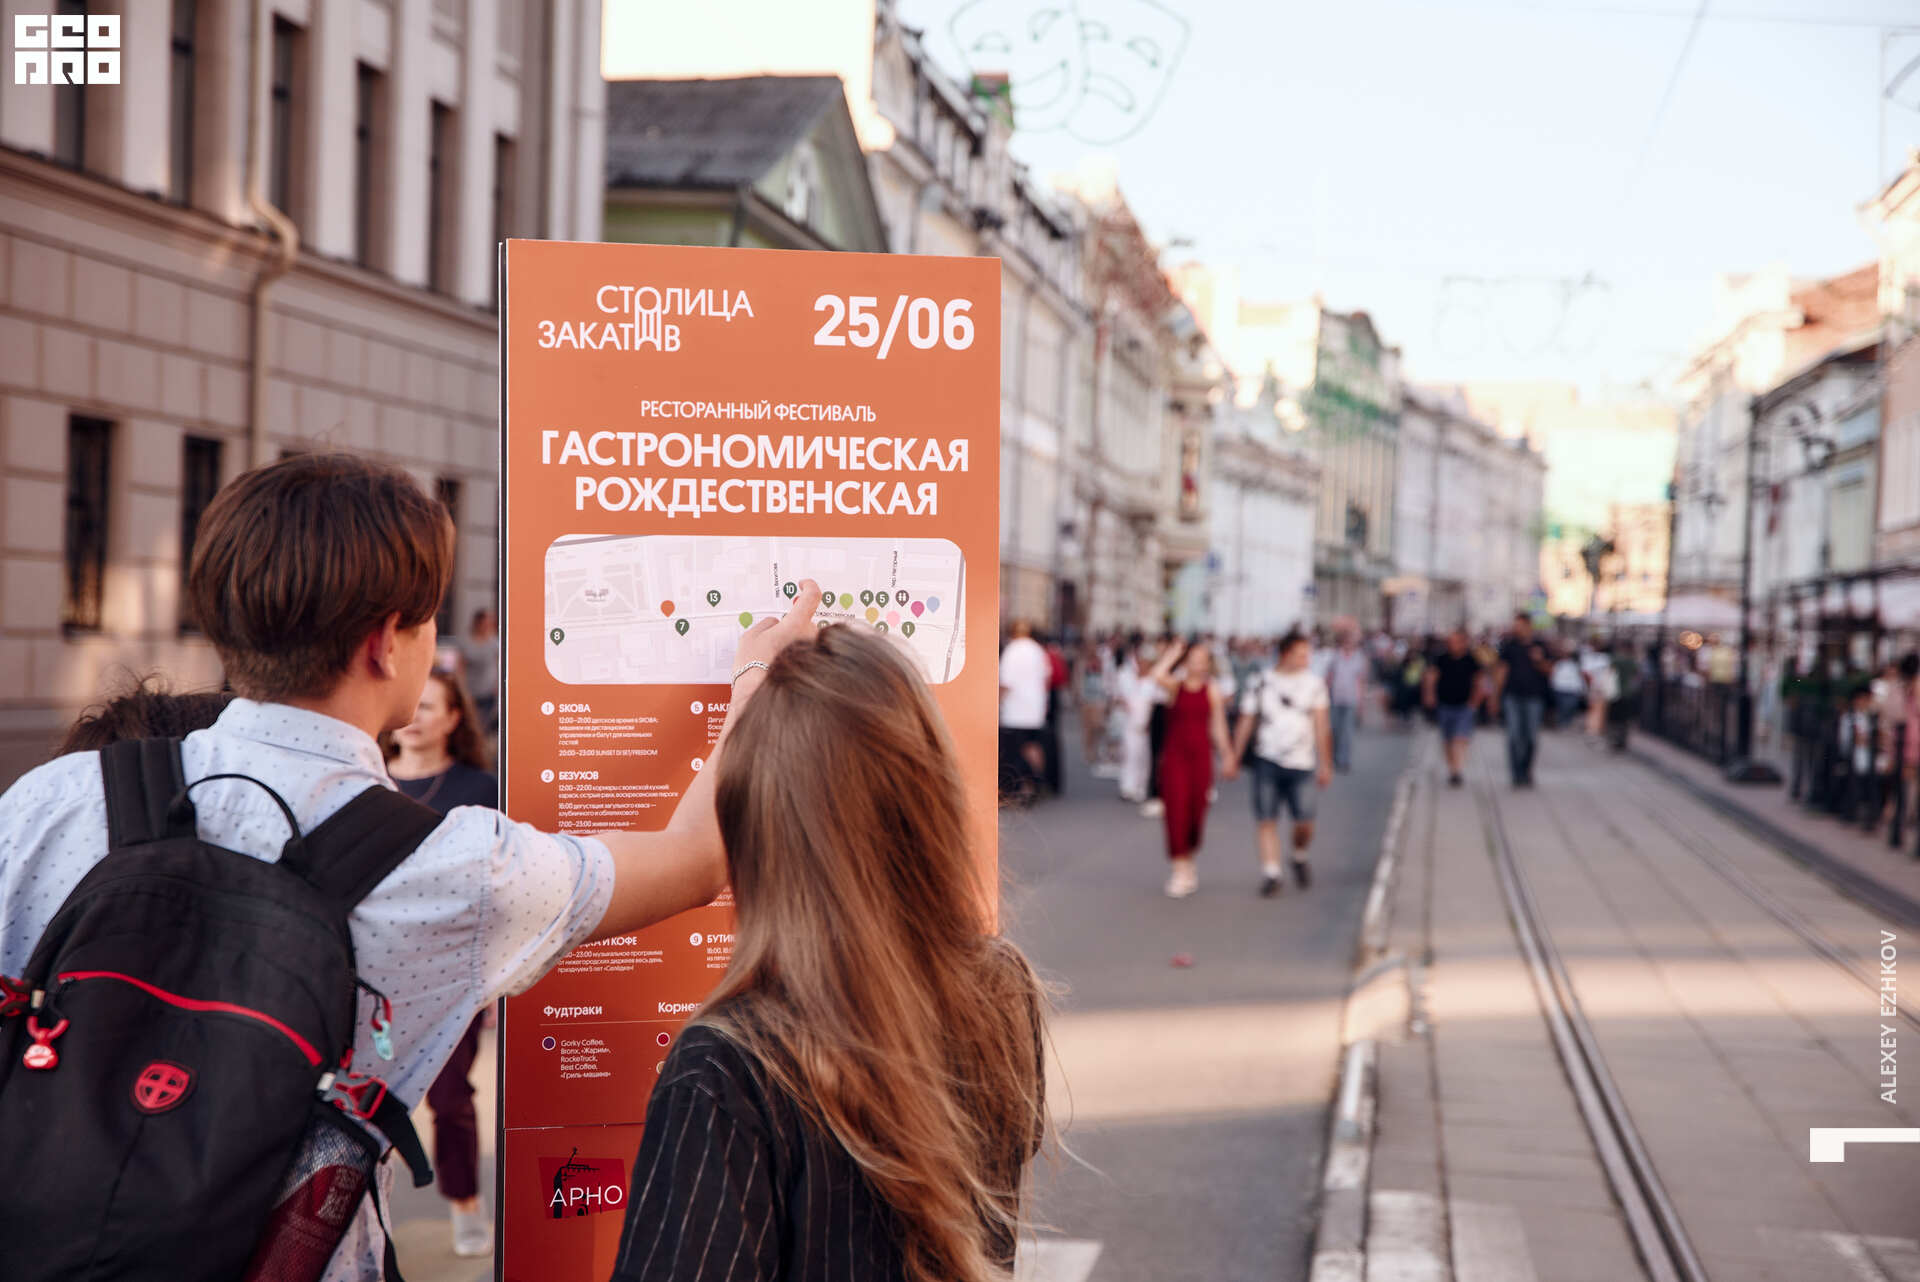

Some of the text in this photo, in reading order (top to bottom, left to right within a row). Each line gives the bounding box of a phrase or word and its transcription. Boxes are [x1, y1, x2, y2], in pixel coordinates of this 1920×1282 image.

[596, 286, 755, 322] СТОЛИЦА
[813, 294, 975, 360] 25/06
[640, 400, 877, 423] РЕСТОРАННЫЙ ФЕСТИВАЛЬ
[541, 430, 970, 472] ГАСТРОНОМИЧЕСКАЯ
[575, 477, 939, 518] РОЖДЕСТВЕНСКАЯ
[559, 771, 599, 781] БЕЗУХОВ
[611, 936, 638, 946] КОФЕ
[543, 1005, 603, 1018] Фудтраки
[560, 1039, 581, 1047] Gorky
[549, 1185, 623, 1208] АРНО
